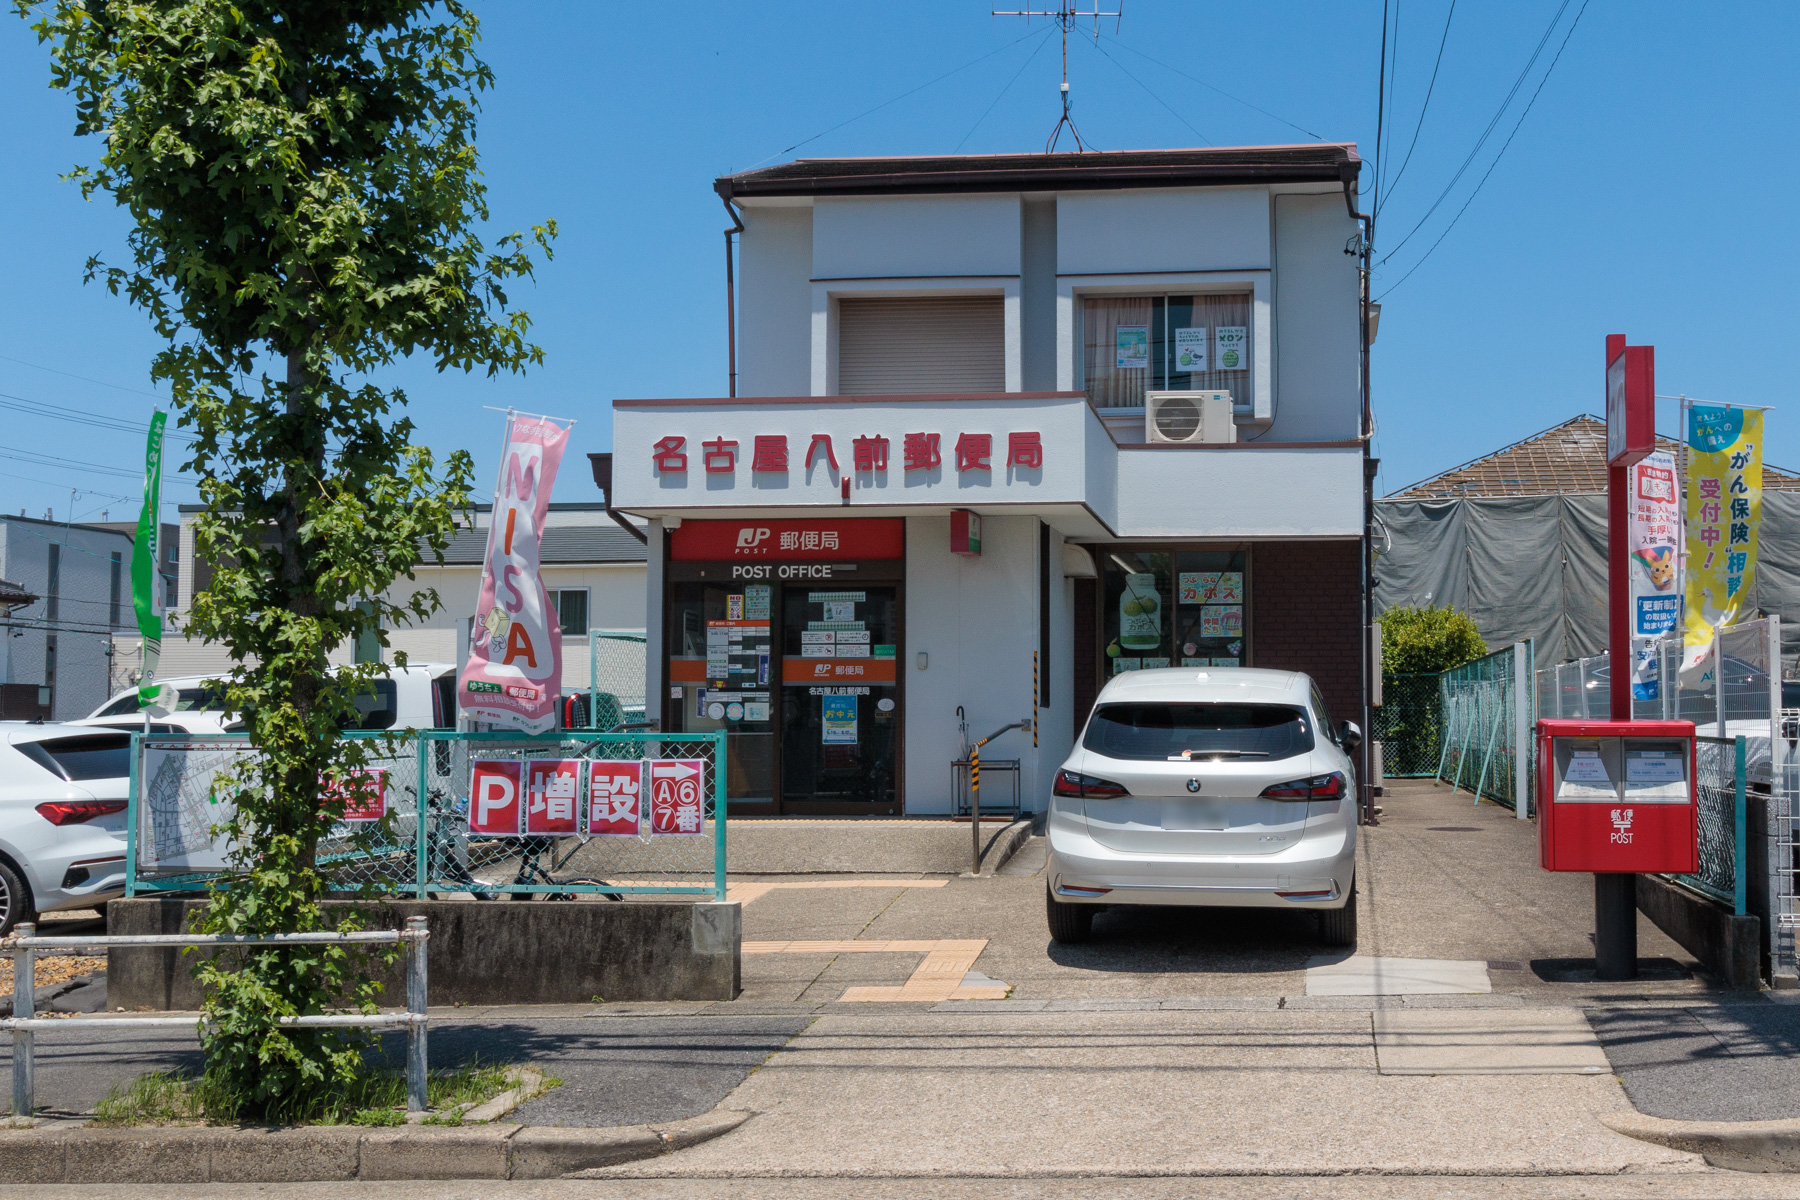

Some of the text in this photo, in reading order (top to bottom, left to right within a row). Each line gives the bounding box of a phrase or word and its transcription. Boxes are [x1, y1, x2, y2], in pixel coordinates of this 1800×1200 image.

[1219, 334, 1243, 342] メロン
[652, 432, 1043, 474] 名古屋八前郵便局
[1699, 478, 1722, 569] 受付中!
[779, 530, 840, 551] 郵便局
[501, 452, 540, 669] NISA
[732, 564, 833, 579] POST OFFICE
[1182, 576, 1217, 584] つぶらな
[835, 665, 864, 676] 郵便局
[469, 681, 501, 693] ゆうちょ
[509, 686, 537, 700] 郵便局
[808, 686, 871, 696] 名古屋八前郵便局
[825, 710, 856, 719] お中元
[477, 771, 639, 826] P 増設
[1610, 808, 1634, 823] 郵便
[1610, 833, 1634, 844] POST
